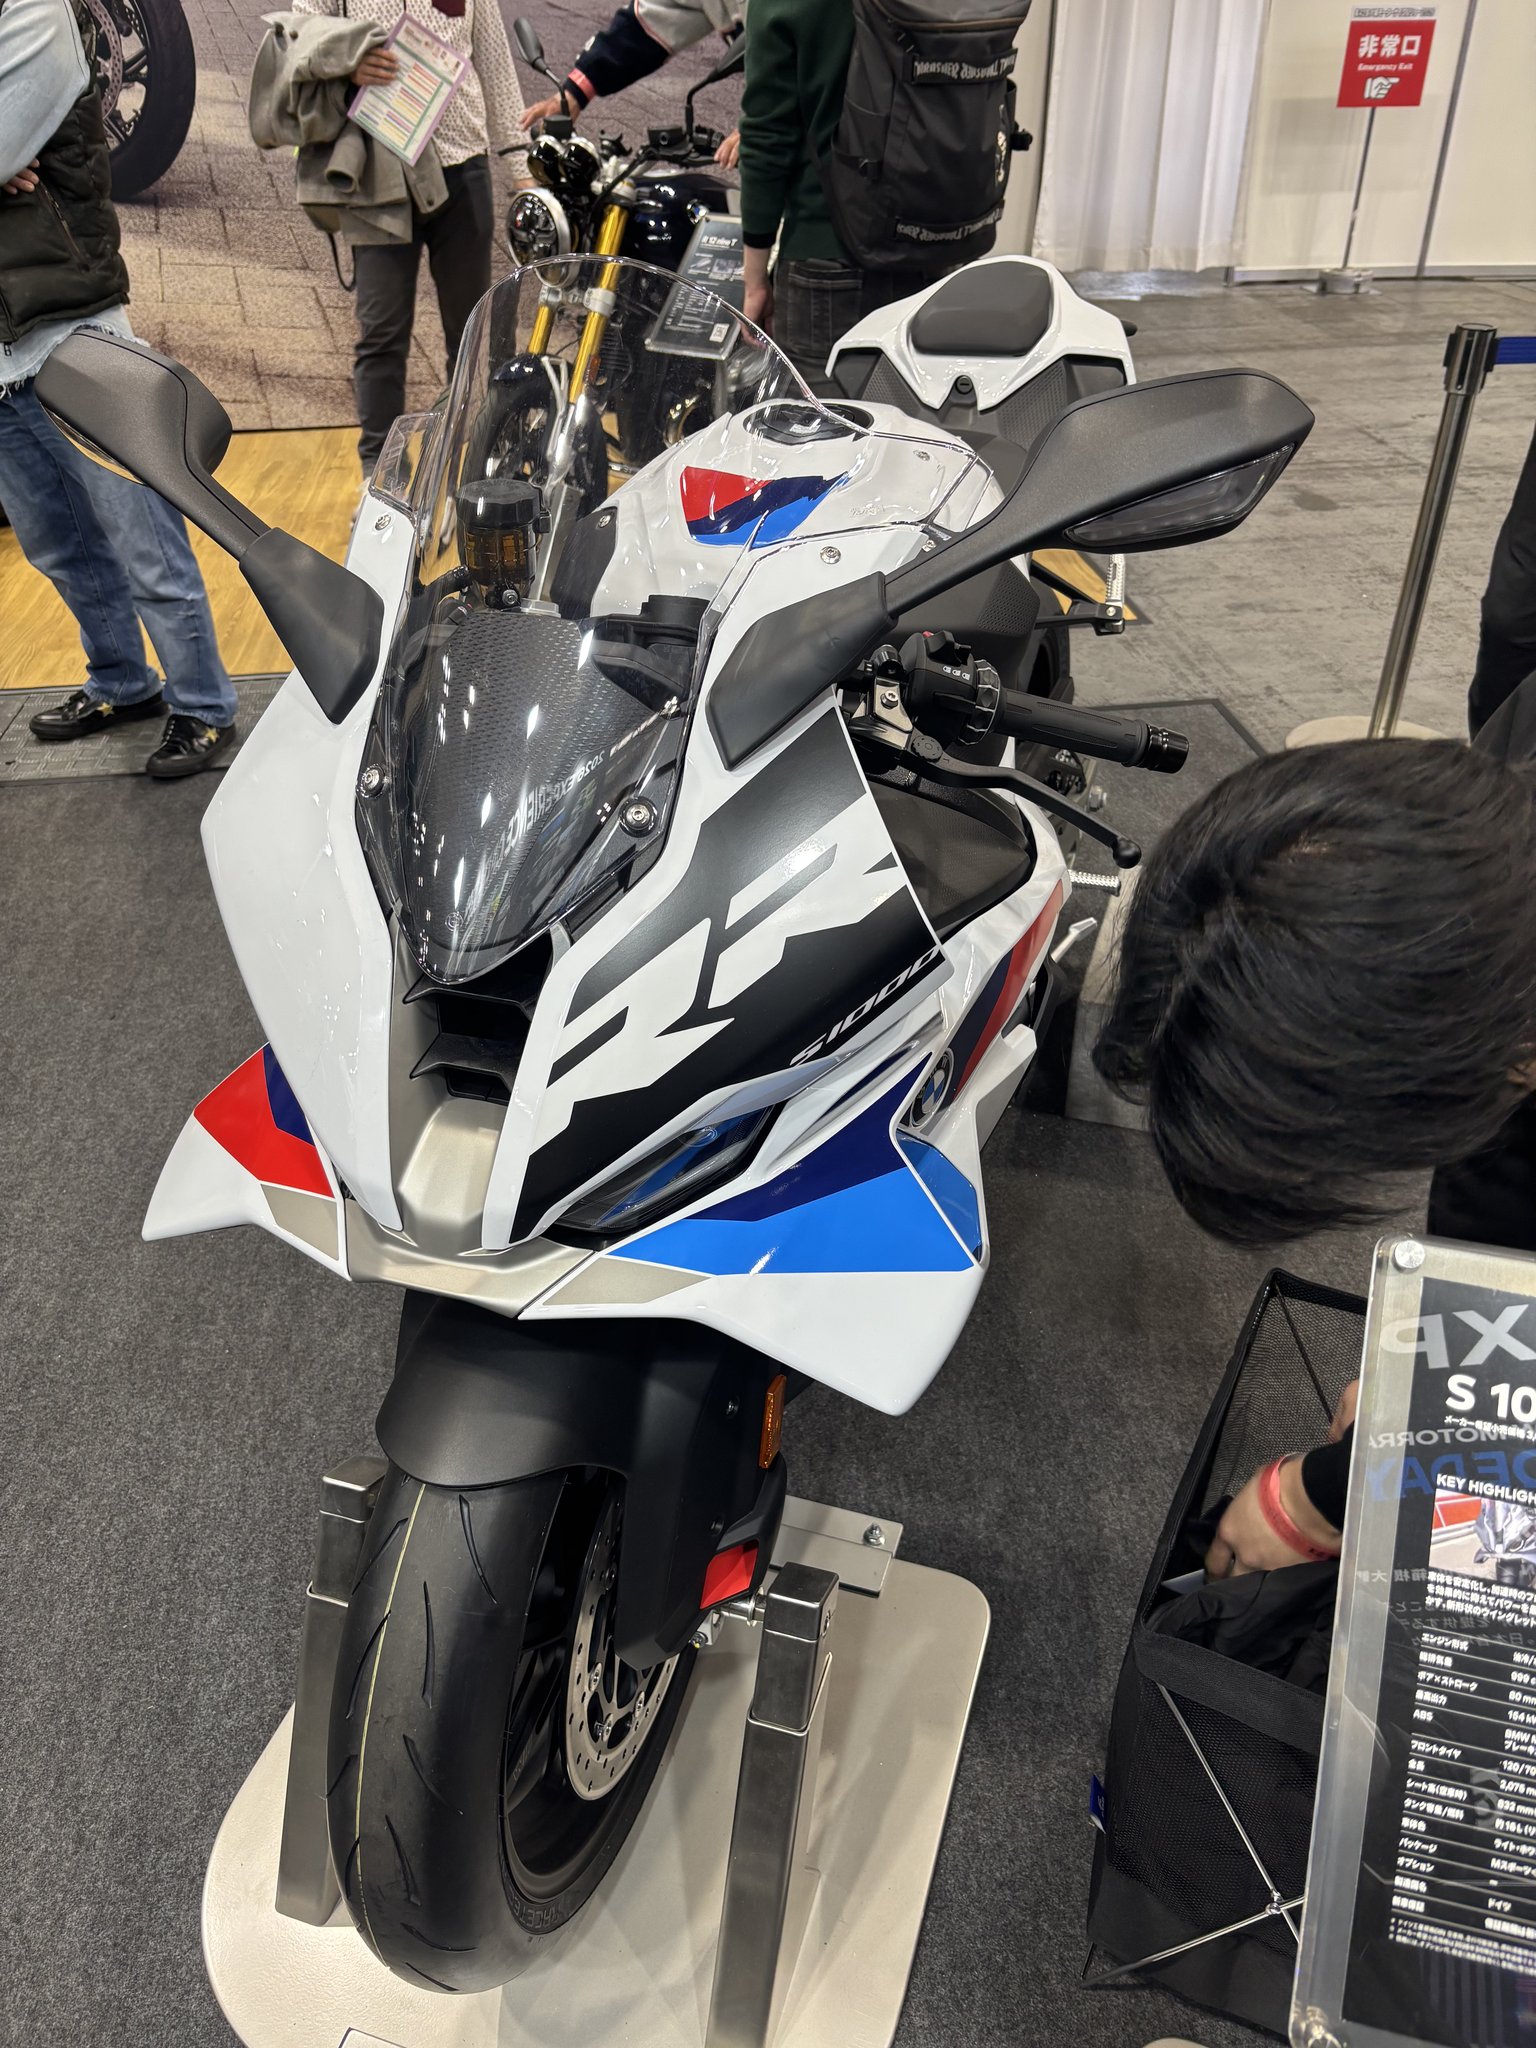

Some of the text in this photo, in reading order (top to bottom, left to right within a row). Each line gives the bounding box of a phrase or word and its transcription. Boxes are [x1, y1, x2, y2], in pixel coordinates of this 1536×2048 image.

[1358, 34, 1422, 58] 非常口
[1357, 62, 1414, 72] Emergency Exit
[789, 948, 940, 1067] S1000
[1446, 1374, 1477, 1411] S
[1437, 1473, 1465, 1490] KEY
[1421, 1633, 1469, 1652] エンジン形式
[1417, 1671, 1478, 1692] ボア×ストローク
[1415, 1689, 1447, 1706] 最高出力
[1509, 1690, 1522, 1702] 80
[1413, 1709, 1434, 1722] ABS
[1505, 1728, 1530, 1743] BMW
[1411, 1739, 1462, 1760] フロントタイヤ
[1408, 1758, 1425, 1772] 全長
[1401, 1817, 1426, 1832] 車体色
[1399, 1838, 1437, 1854] パッケージ
[1397, 1856, 1434, 1872] オプション
[1488, 1898, 1512, 1912] ドイツ
